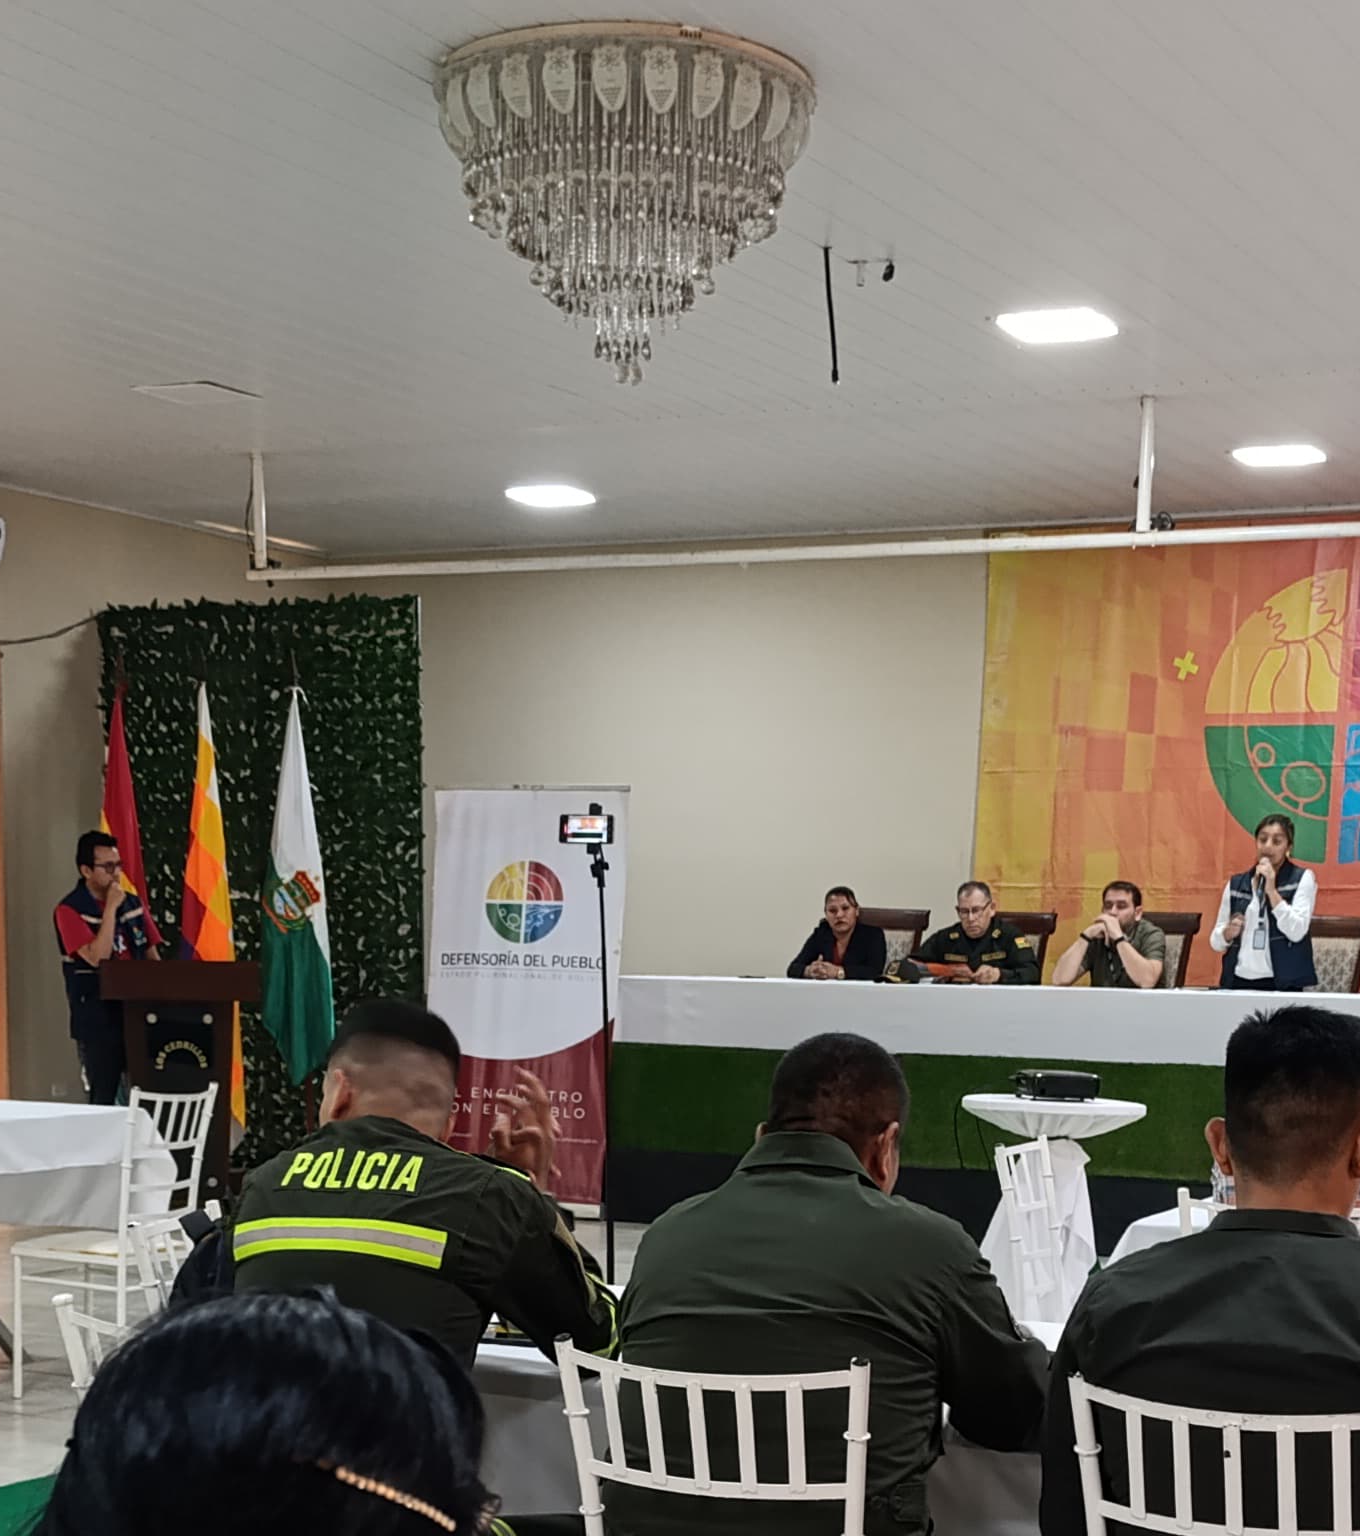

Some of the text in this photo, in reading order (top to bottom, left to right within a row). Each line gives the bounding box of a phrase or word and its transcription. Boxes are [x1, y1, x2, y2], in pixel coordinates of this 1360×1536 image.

[441, 950, 520, 966] DEFENSORÍA
[523, 954, 548, 967] DEL
[483, 1104, 500, 1115] EL
[281, 1148, 423, 1192] POLICIA
